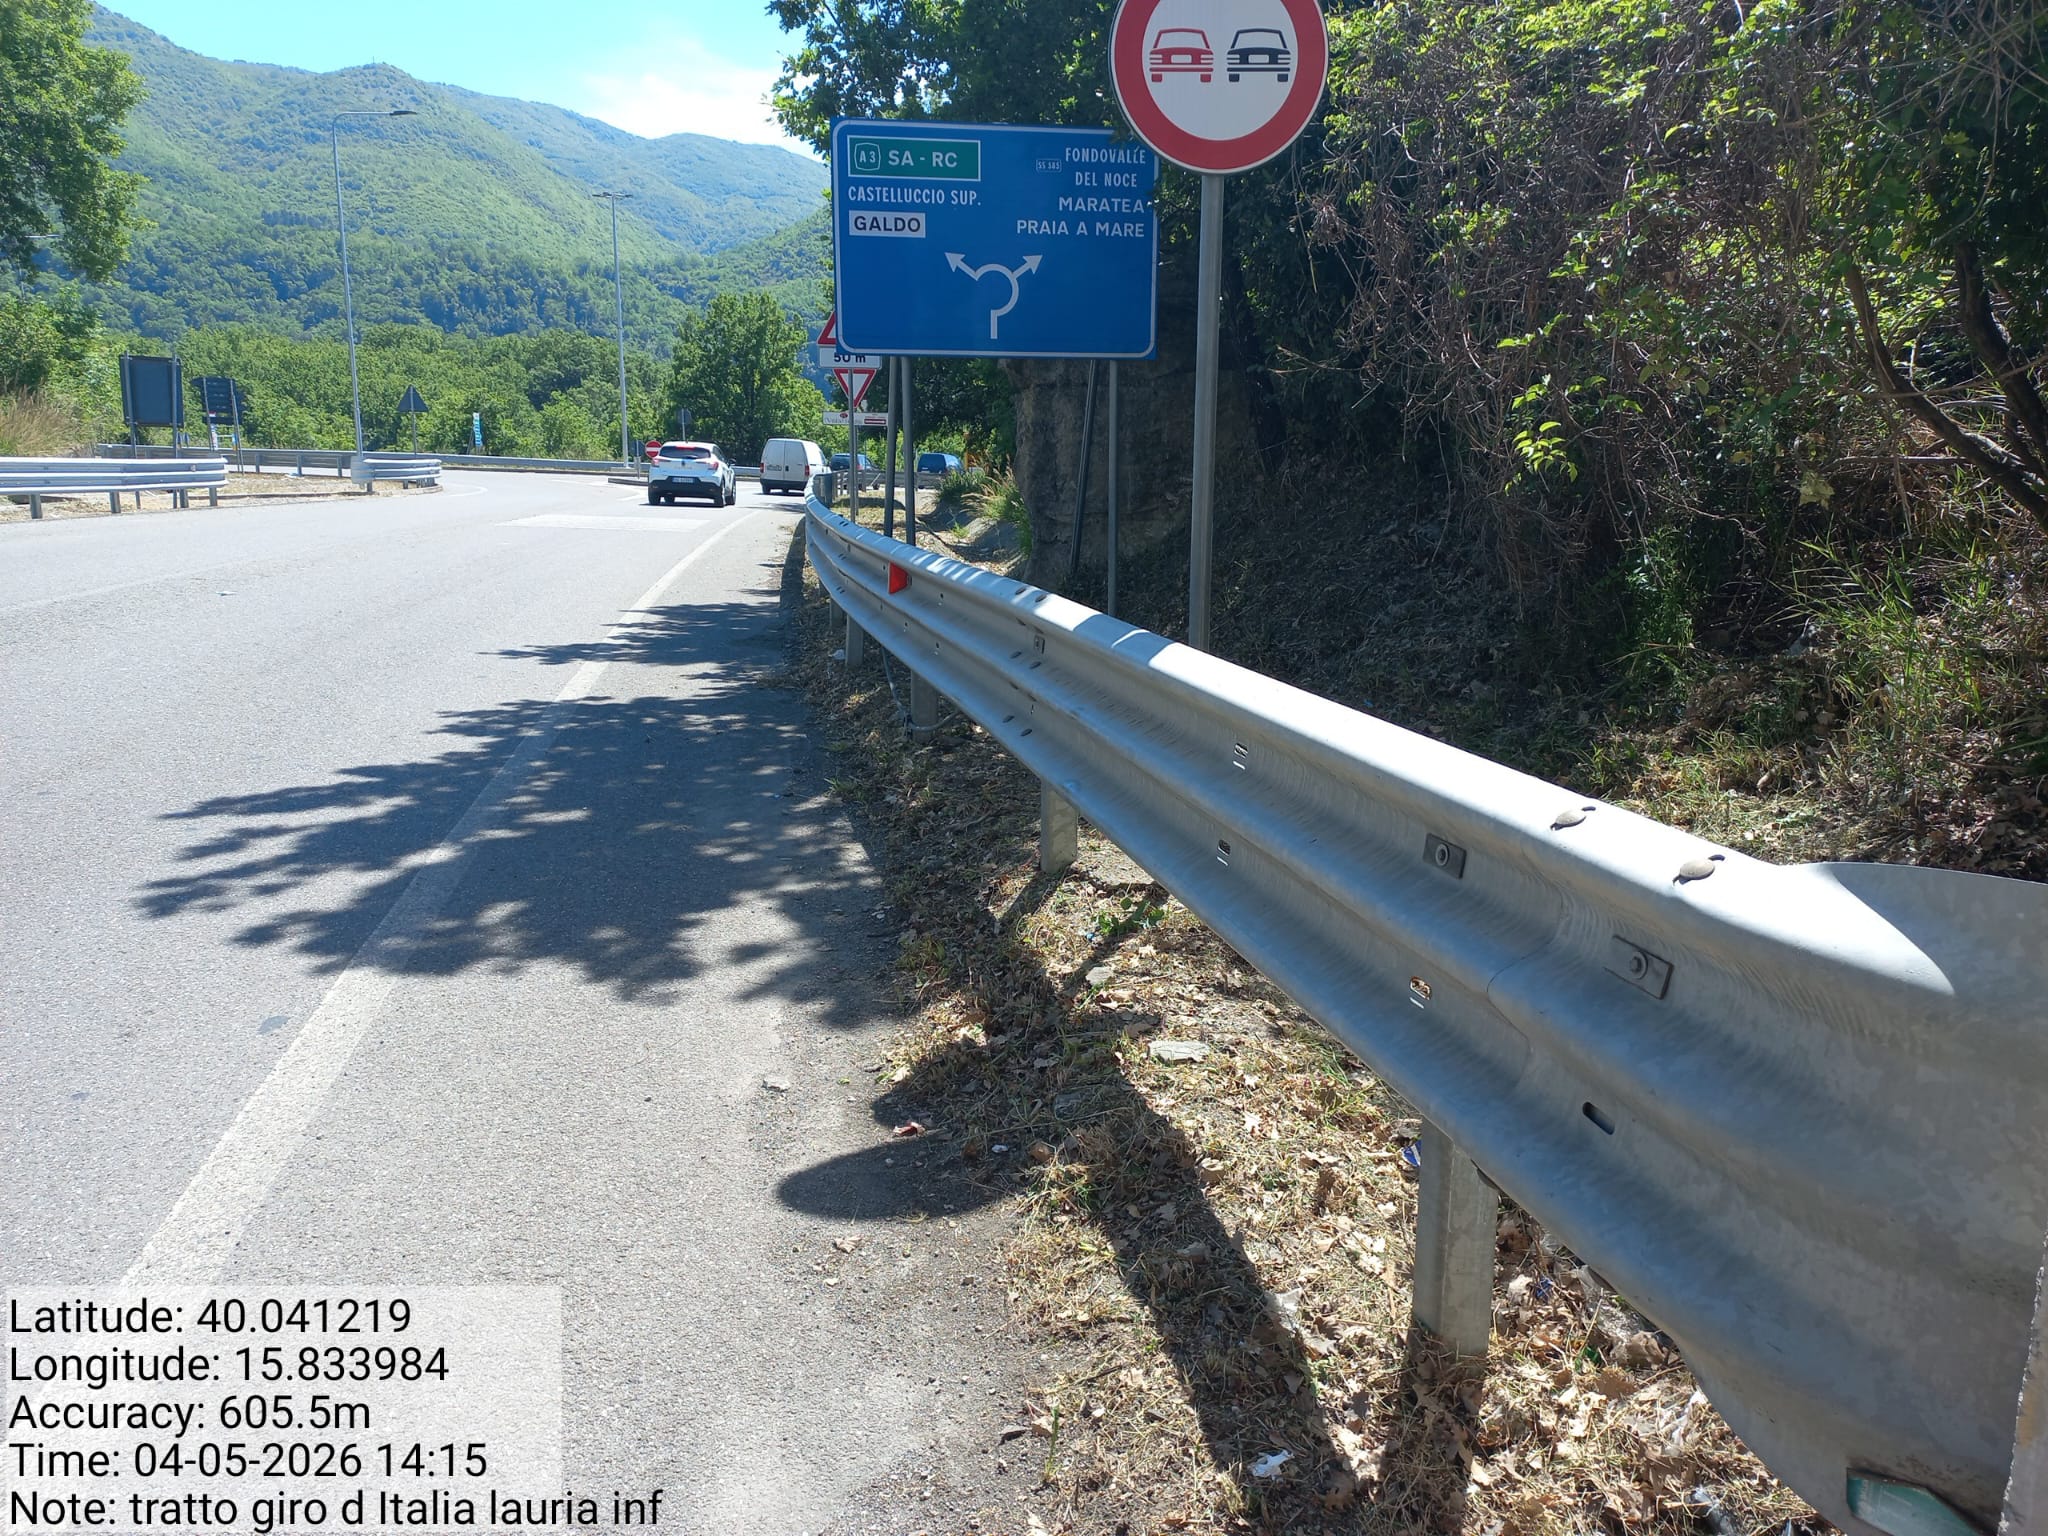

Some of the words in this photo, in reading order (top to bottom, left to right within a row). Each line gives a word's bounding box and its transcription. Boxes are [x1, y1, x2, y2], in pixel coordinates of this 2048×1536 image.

[888, 150, 914, 167] SA
[932, 151, 958, 168] RC
[1065, 147, 1146, 164] FONDOVALLE
[1075, 171, 1098, 187] DEL
[1104, 172, 1138, 188] NOCE
[848, 186, 945, 204] CASTELLUCCIO
[950, 190, 981, 206] SUP.
[1059, 197, 1145, 213] MARATEA
[854, 215, 921, 233] GALDO
[1016, 219, 1069, 235] PRAIA
[1076, 221, 1088, 236] A
[1095, 221, 1145, 237] MARE
[834, 352, 851, 363] 50
